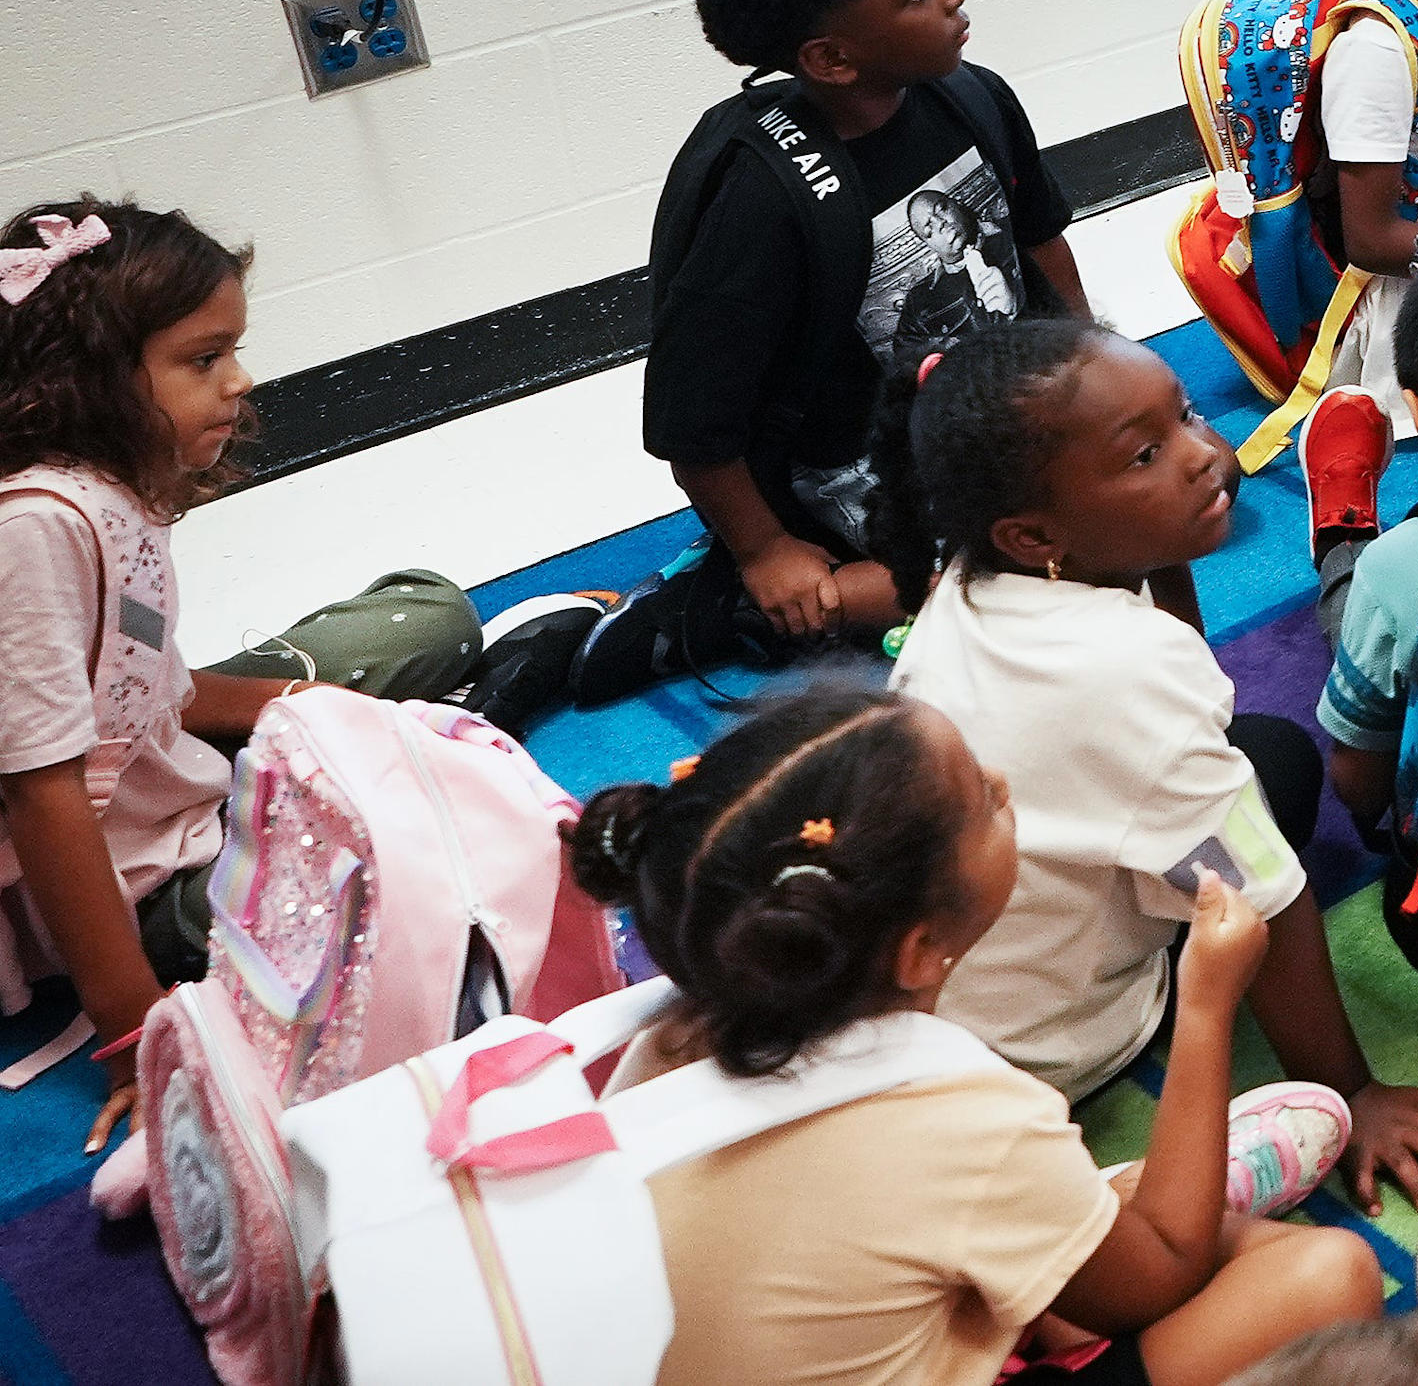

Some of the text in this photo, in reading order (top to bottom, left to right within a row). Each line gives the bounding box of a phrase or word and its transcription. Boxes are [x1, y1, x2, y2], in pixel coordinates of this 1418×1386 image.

[1243, 19, 1254, 57] HELLO
[1243, 62, 1263, 99] KITTY
[757, 107, 840, 201] NIKE AIR
